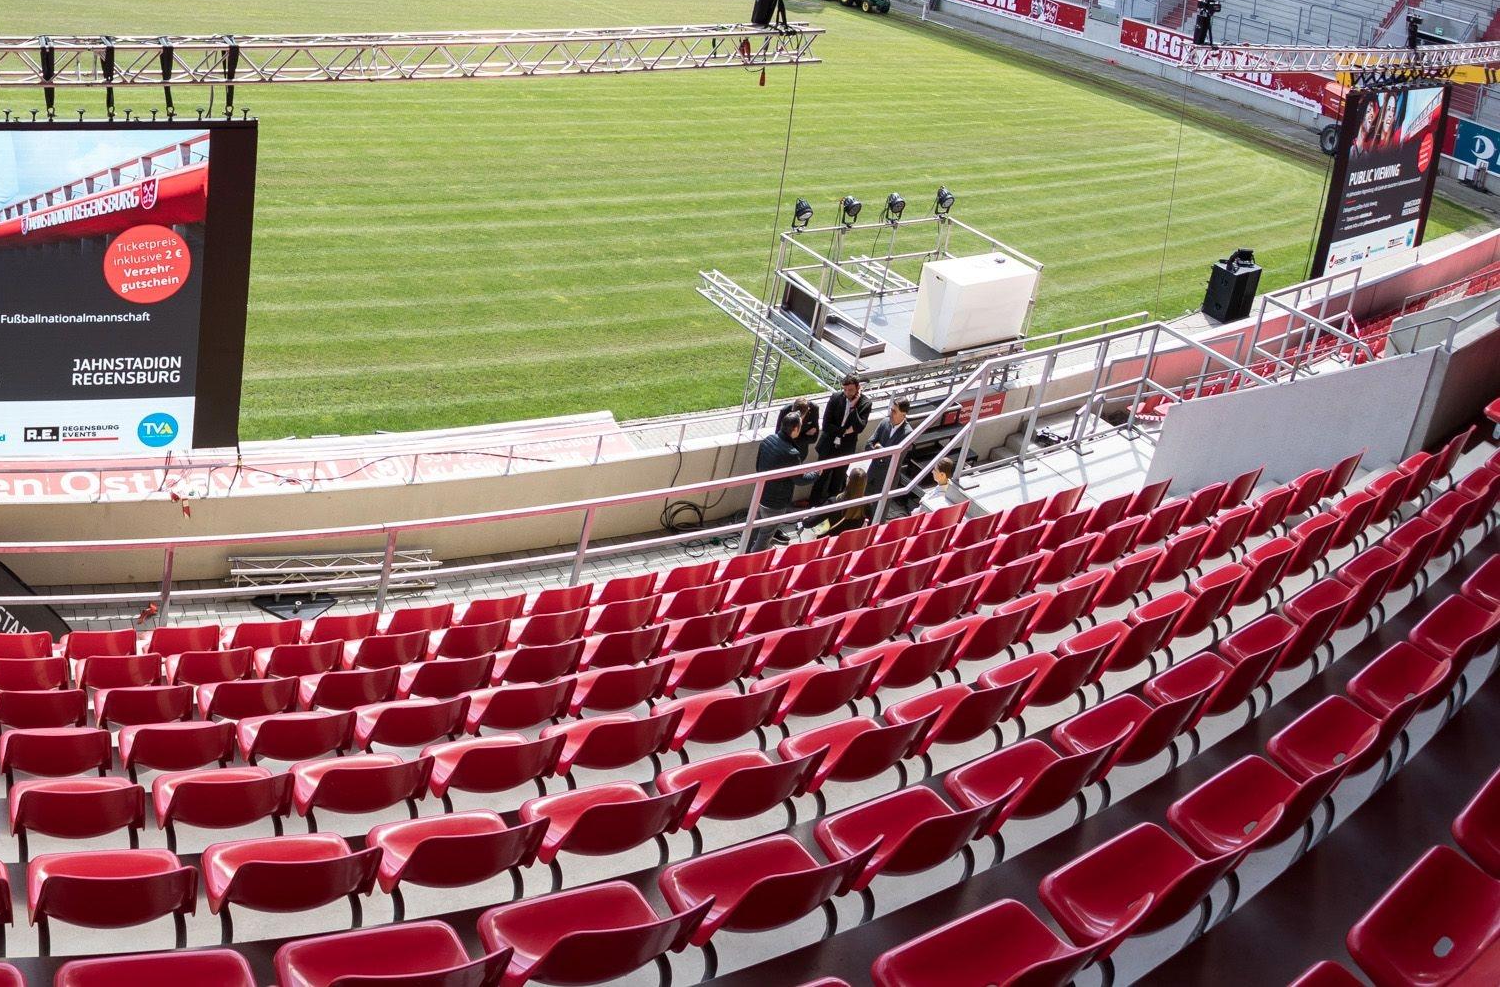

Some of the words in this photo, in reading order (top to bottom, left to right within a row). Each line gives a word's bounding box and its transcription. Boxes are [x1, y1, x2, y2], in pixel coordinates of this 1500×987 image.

[1349, 169, 1374, 186] PUBLIC
[1374, 163, 1401, 181] VIEWING
[72, 188, 140, 221] REGENSBURG
[117, 238, 177, 252] Ticketpreis
[113, 253, 162, 266] inklusive
[165, 249, 172, 259] 2
[175, 249, 183, 258] €
[123, 264, 174, 277] Verzehr-
[121, 276, 180, 293] gutschein
[0, 312, 151, 324] Fußballnationalmannschaft
[73, 356, 182, 372] JAHNSTADION
[72, 370, 181, 386] REGENSBURG
[142, 421, 174, 436] TVA
